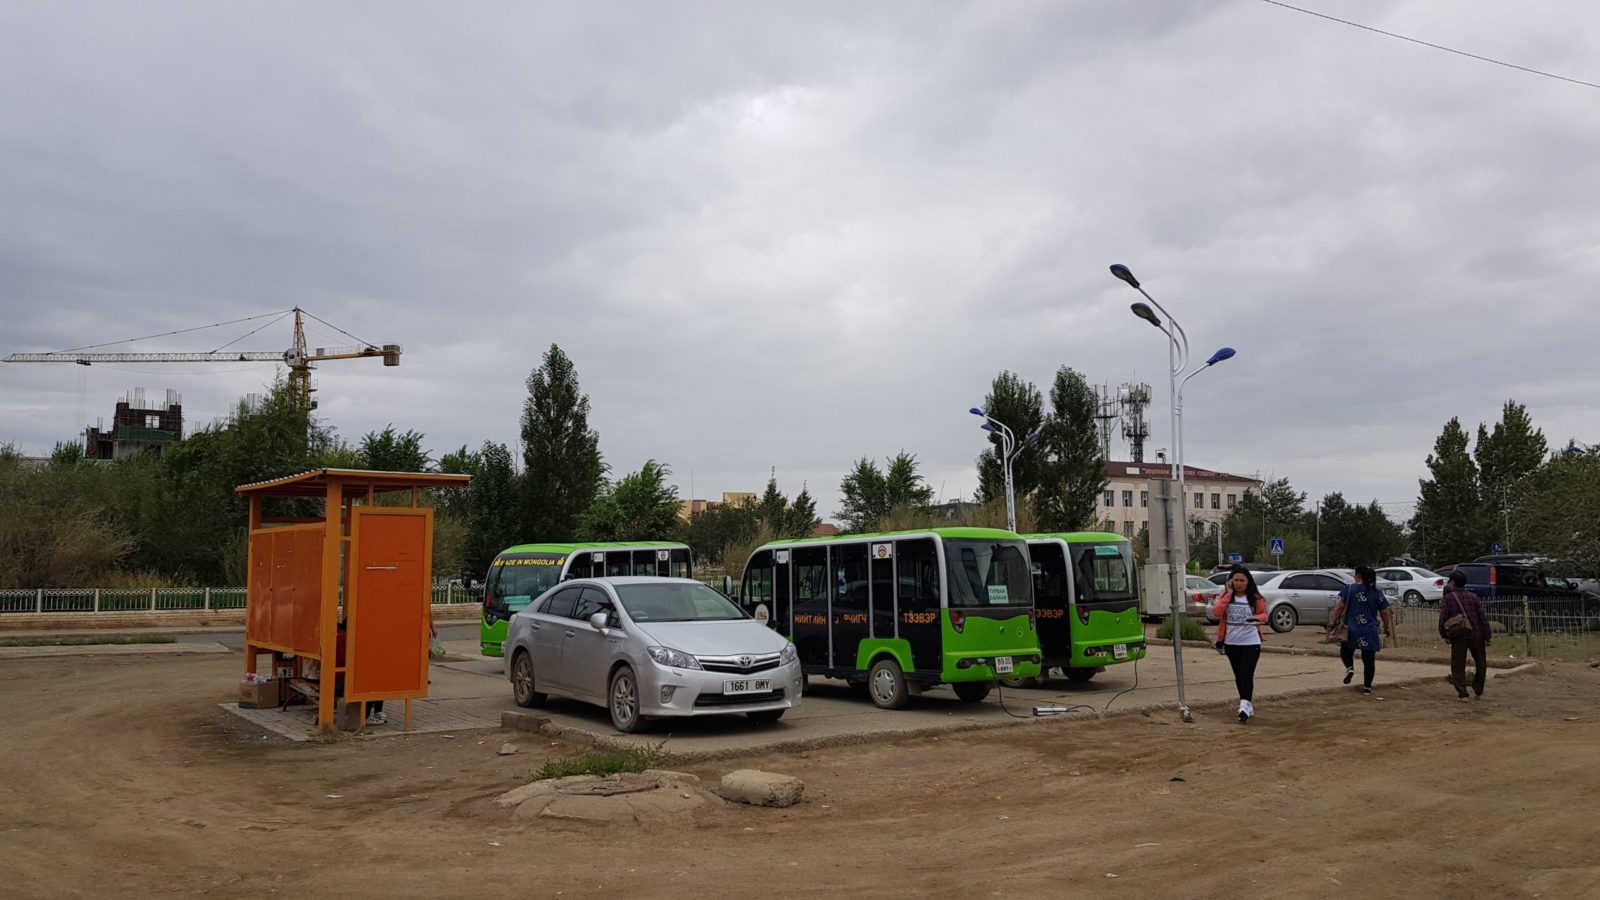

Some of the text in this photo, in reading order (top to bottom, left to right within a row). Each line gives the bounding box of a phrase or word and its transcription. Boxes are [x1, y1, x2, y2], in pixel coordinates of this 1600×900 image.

[903, 612, 936, 624] ТЭЭВЭР
[1035, 609, 1064, 618] ЭЭВЭР
[731, 681, 748, 691] 1661
